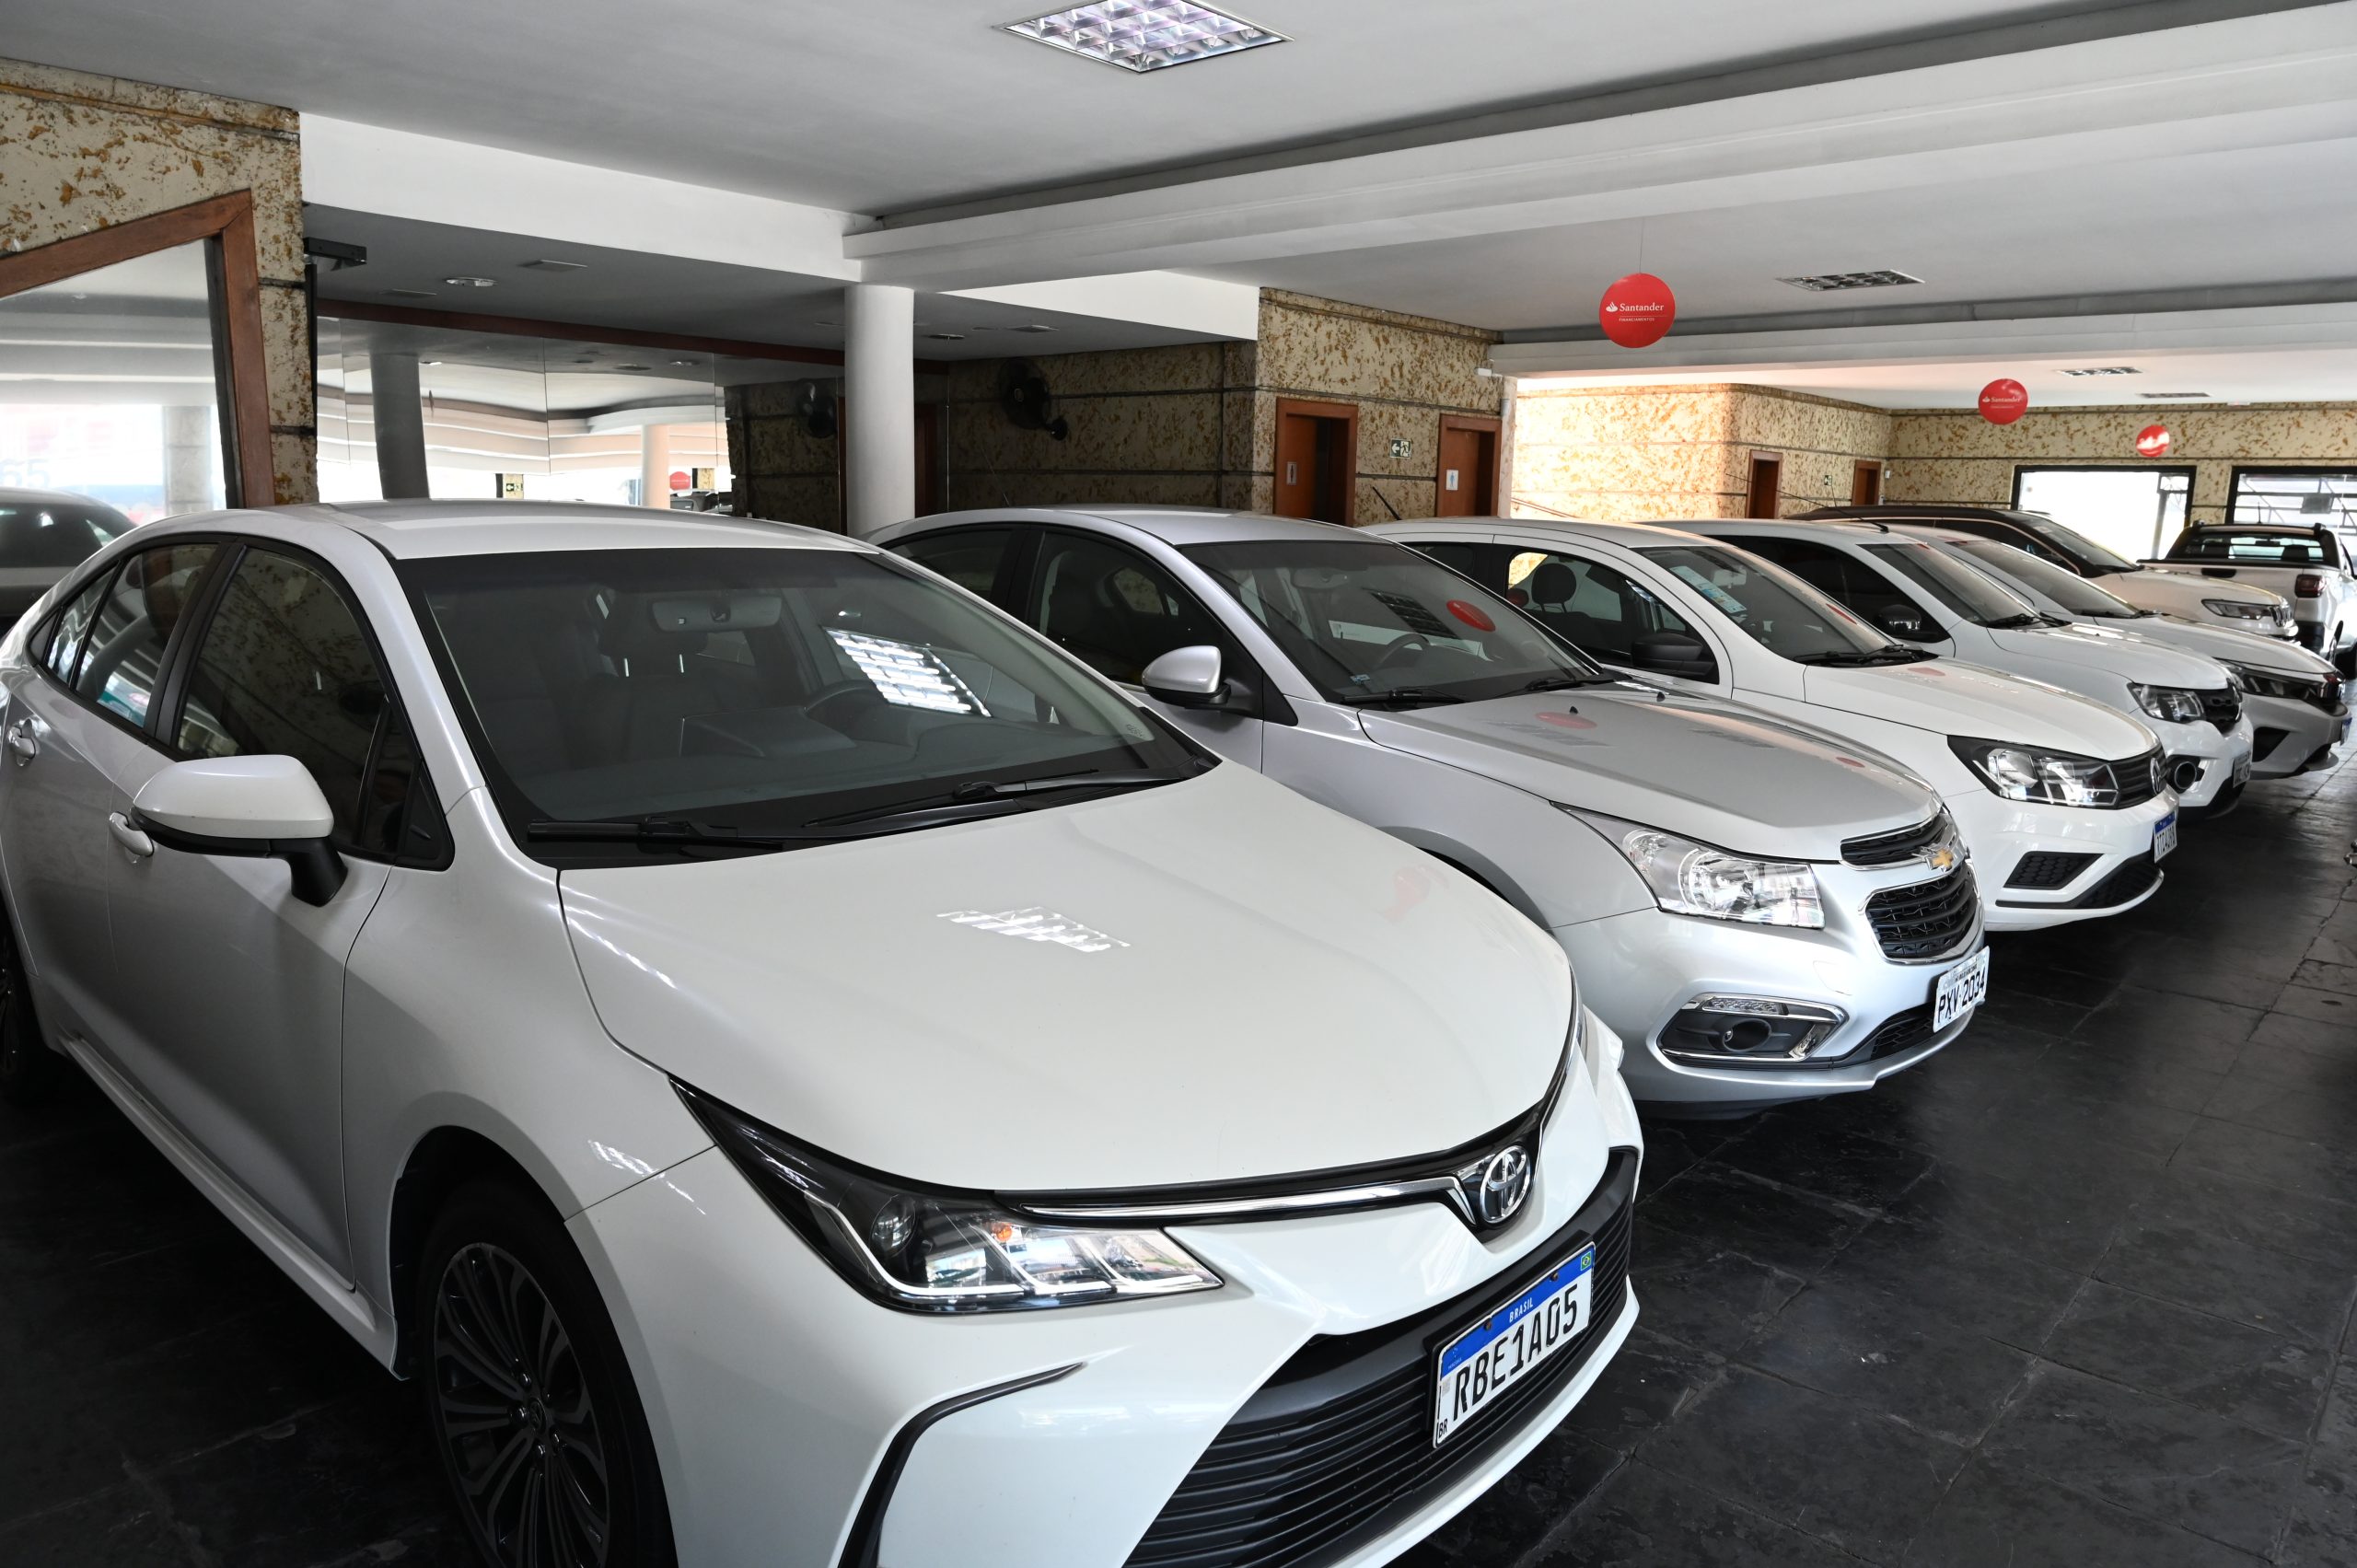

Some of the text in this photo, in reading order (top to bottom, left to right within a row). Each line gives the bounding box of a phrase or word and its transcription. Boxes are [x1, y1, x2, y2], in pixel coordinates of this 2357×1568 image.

[1619, 302, 1665, 312] Santander
[1508, 1296, 1534, 1324] BRASIL
[1453, 1283, 1579, 1422] RBE1A05
[1438, 1418, 1448, 1439] BR
